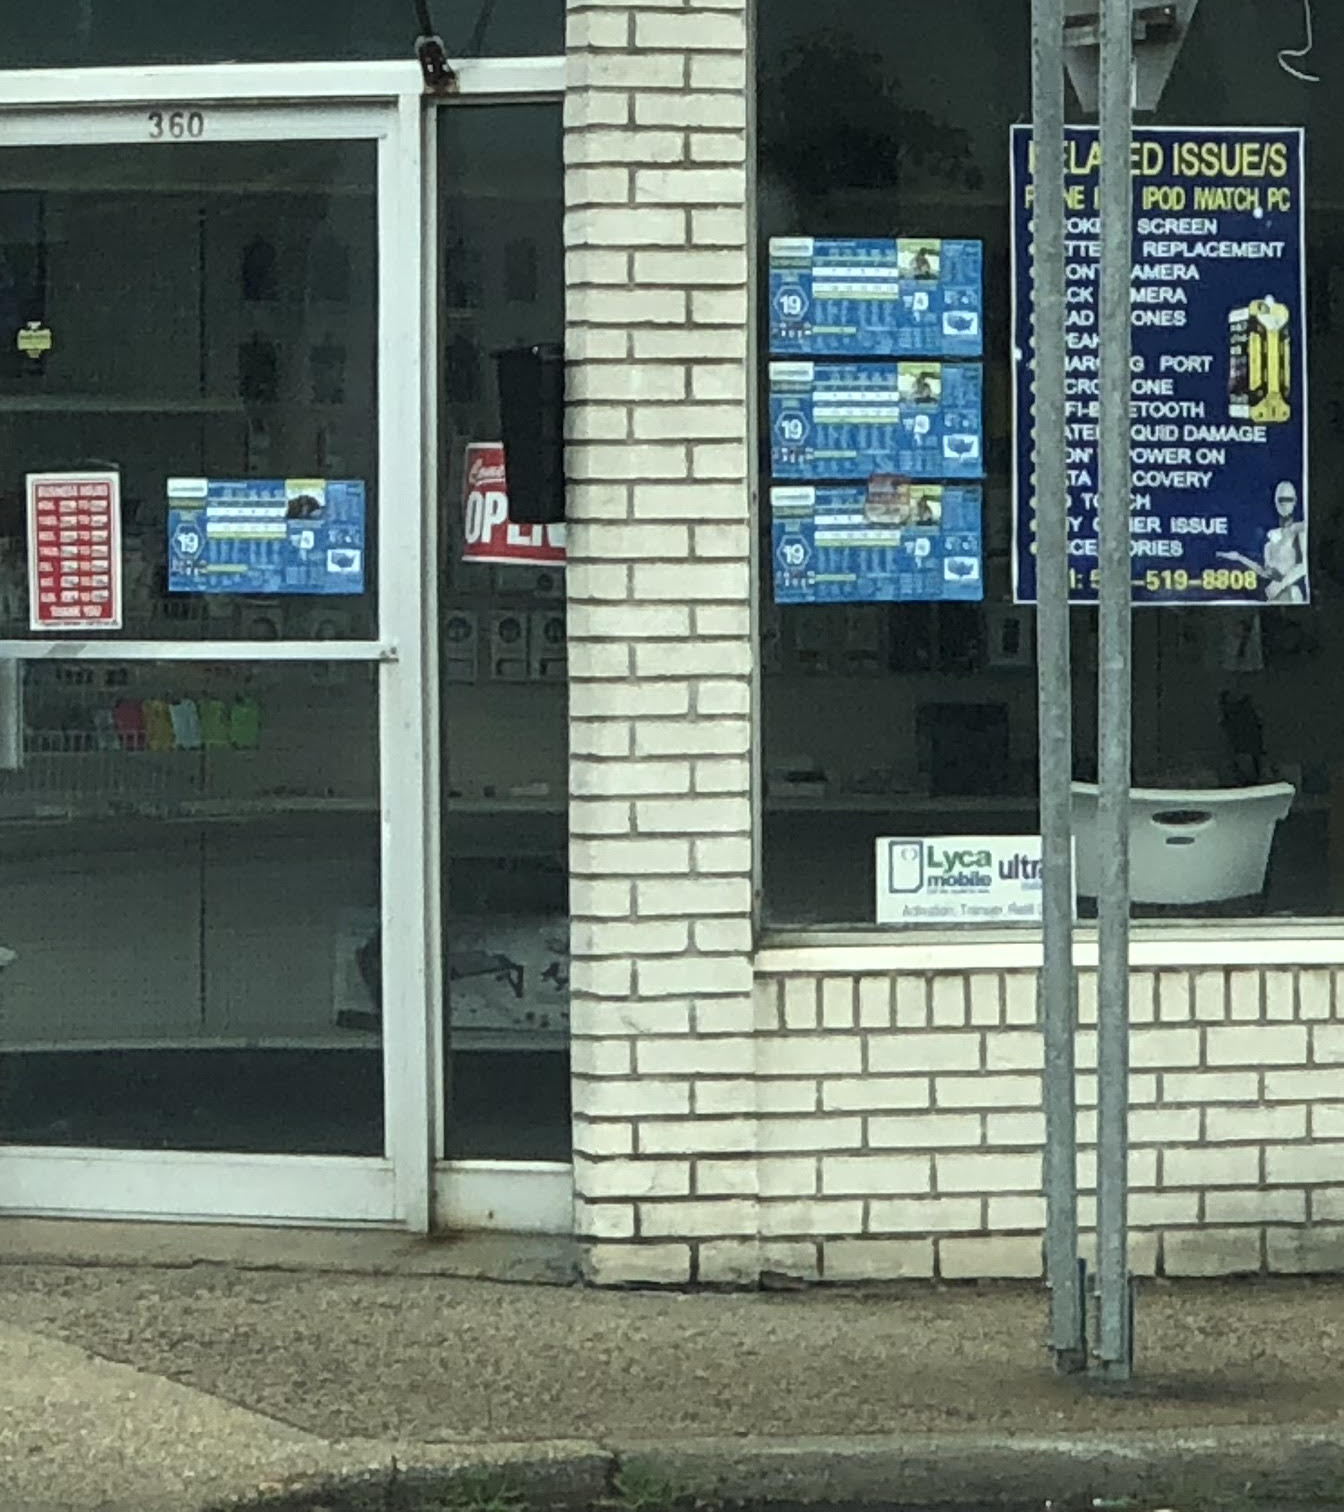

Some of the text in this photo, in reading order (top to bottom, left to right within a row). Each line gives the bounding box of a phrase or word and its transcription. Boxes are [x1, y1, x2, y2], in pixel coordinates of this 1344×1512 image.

[148, 112, 205, 139] 360
[1173, 142, 1288, 178] ISSUE/S
[1142, 186, 1185, 210] IPOD
[1267, 186, 1291, 212] PC
[1137, 218, 1218, 235] SCREEN
[1143, 241, 1285, 258] REPLACEMENT
[1130, 264, 1200, 281] AMERA
[779, 294, 802, 316] 19
[1160, 355, 1213, 372] PORT
[780, 419, 803, 440] 19
[1183, 425, 1267, 442] DAMAGE
[1130, 447, 1192, 465] OWER
[1196, 447, 1225, 465] ON
[1171, 517, 1228, 534] ISSUE
[177, 532, 199, 554] 19
[782, 543, 805, 565] 19
[927, 845, 992, 874] Lyca
[927, 871, 992, 887] mobile
